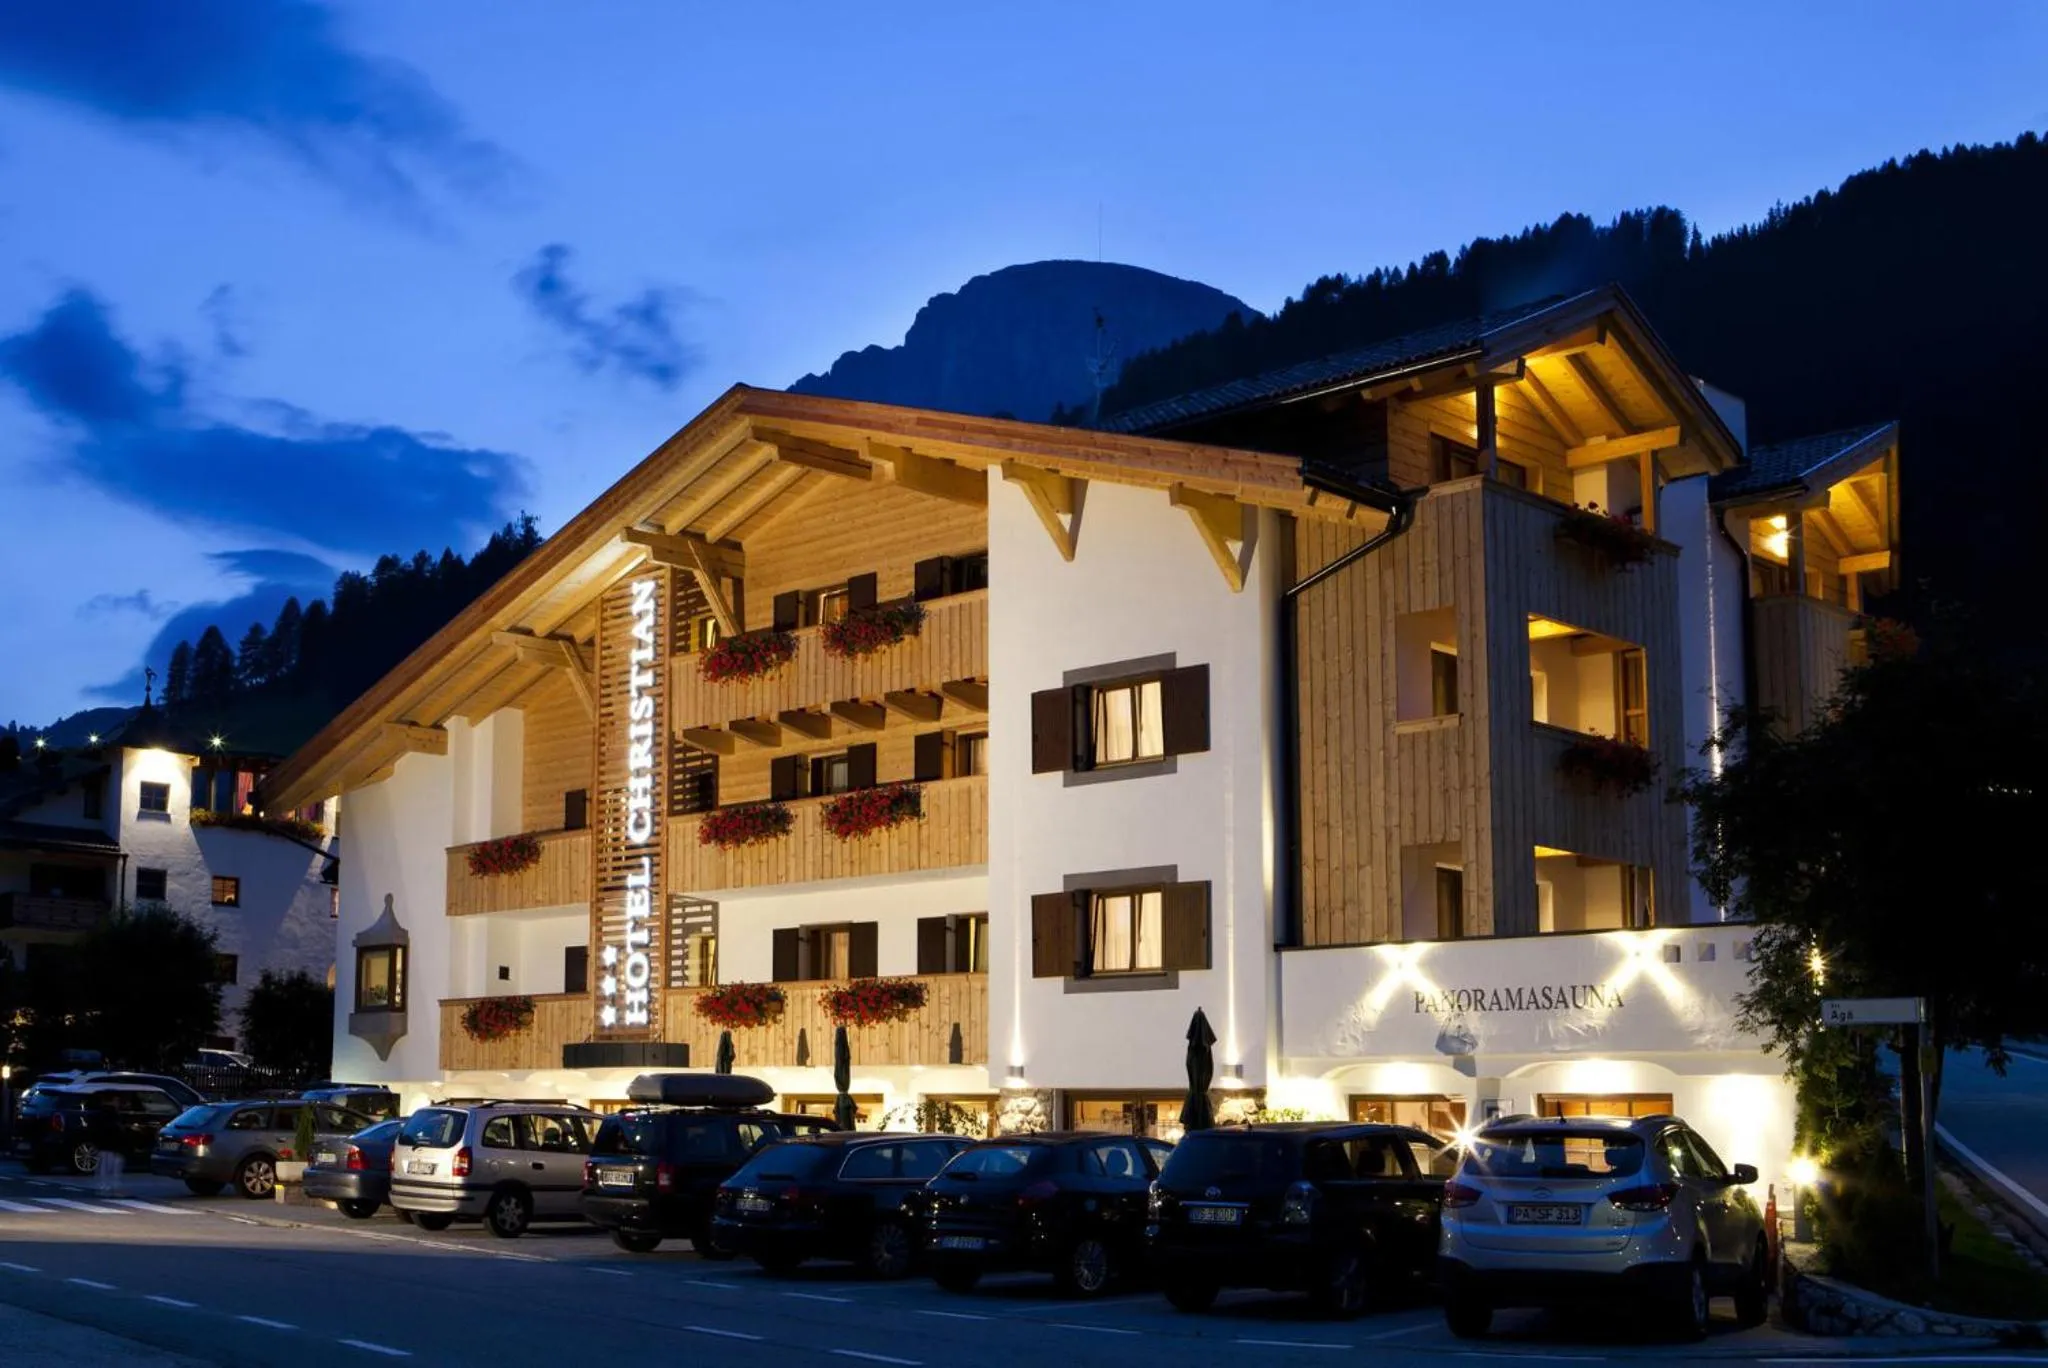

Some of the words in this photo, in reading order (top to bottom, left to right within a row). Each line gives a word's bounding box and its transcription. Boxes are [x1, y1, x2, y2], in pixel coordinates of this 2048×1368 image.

[628, 580, 656, 844] CHRISTIAN
[624, 857, 652, 1026] HOTEL
[1414, 985, 1624, 1013] PANORAMASAUNA
